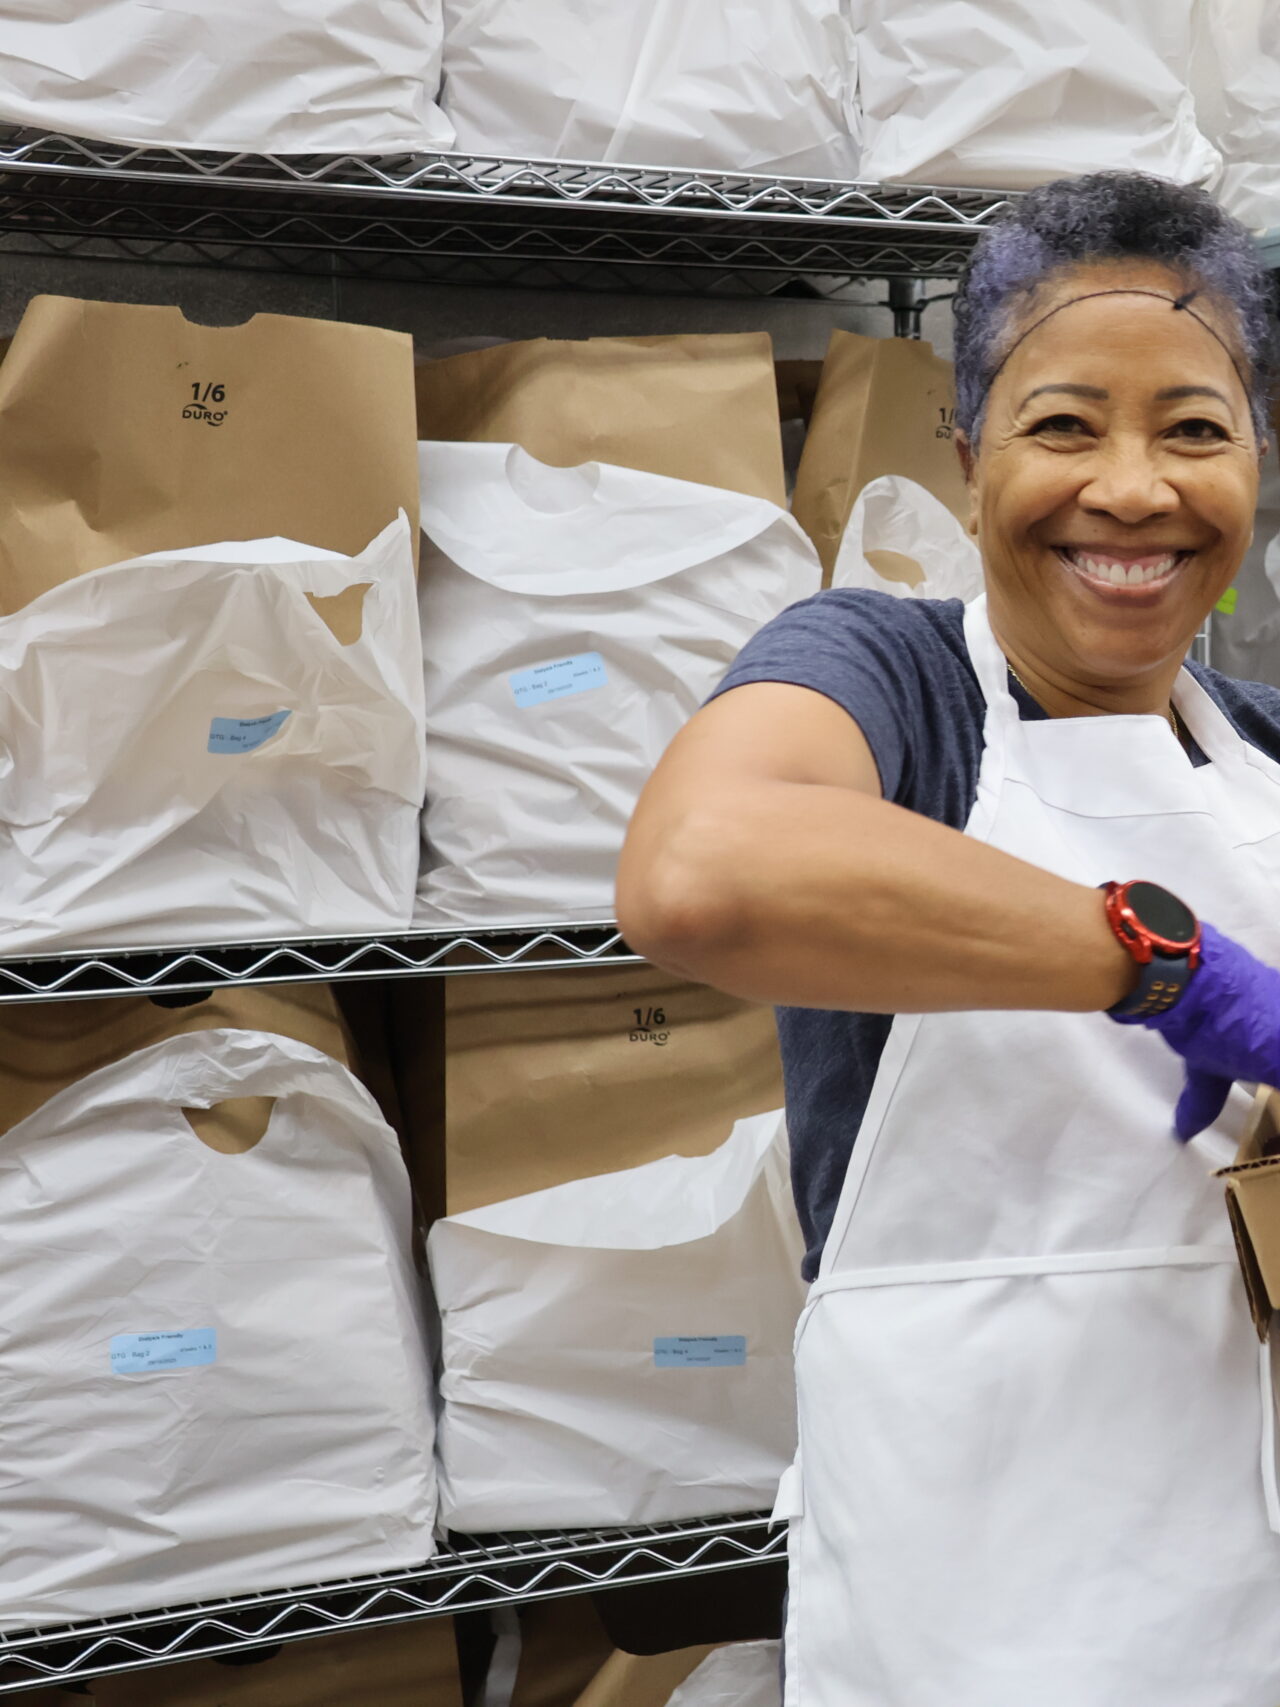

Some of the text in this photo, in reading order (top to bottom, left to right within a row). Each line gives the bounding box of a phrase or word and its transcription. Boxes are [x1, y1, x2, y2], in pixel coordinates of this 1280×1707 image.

[192, 382, 225, 402] 1/6
[182, 409, 228, 421] DURO
[633, 1007, 666, 1025] 1/6
[629, 1032, 671, 1042] DURO
